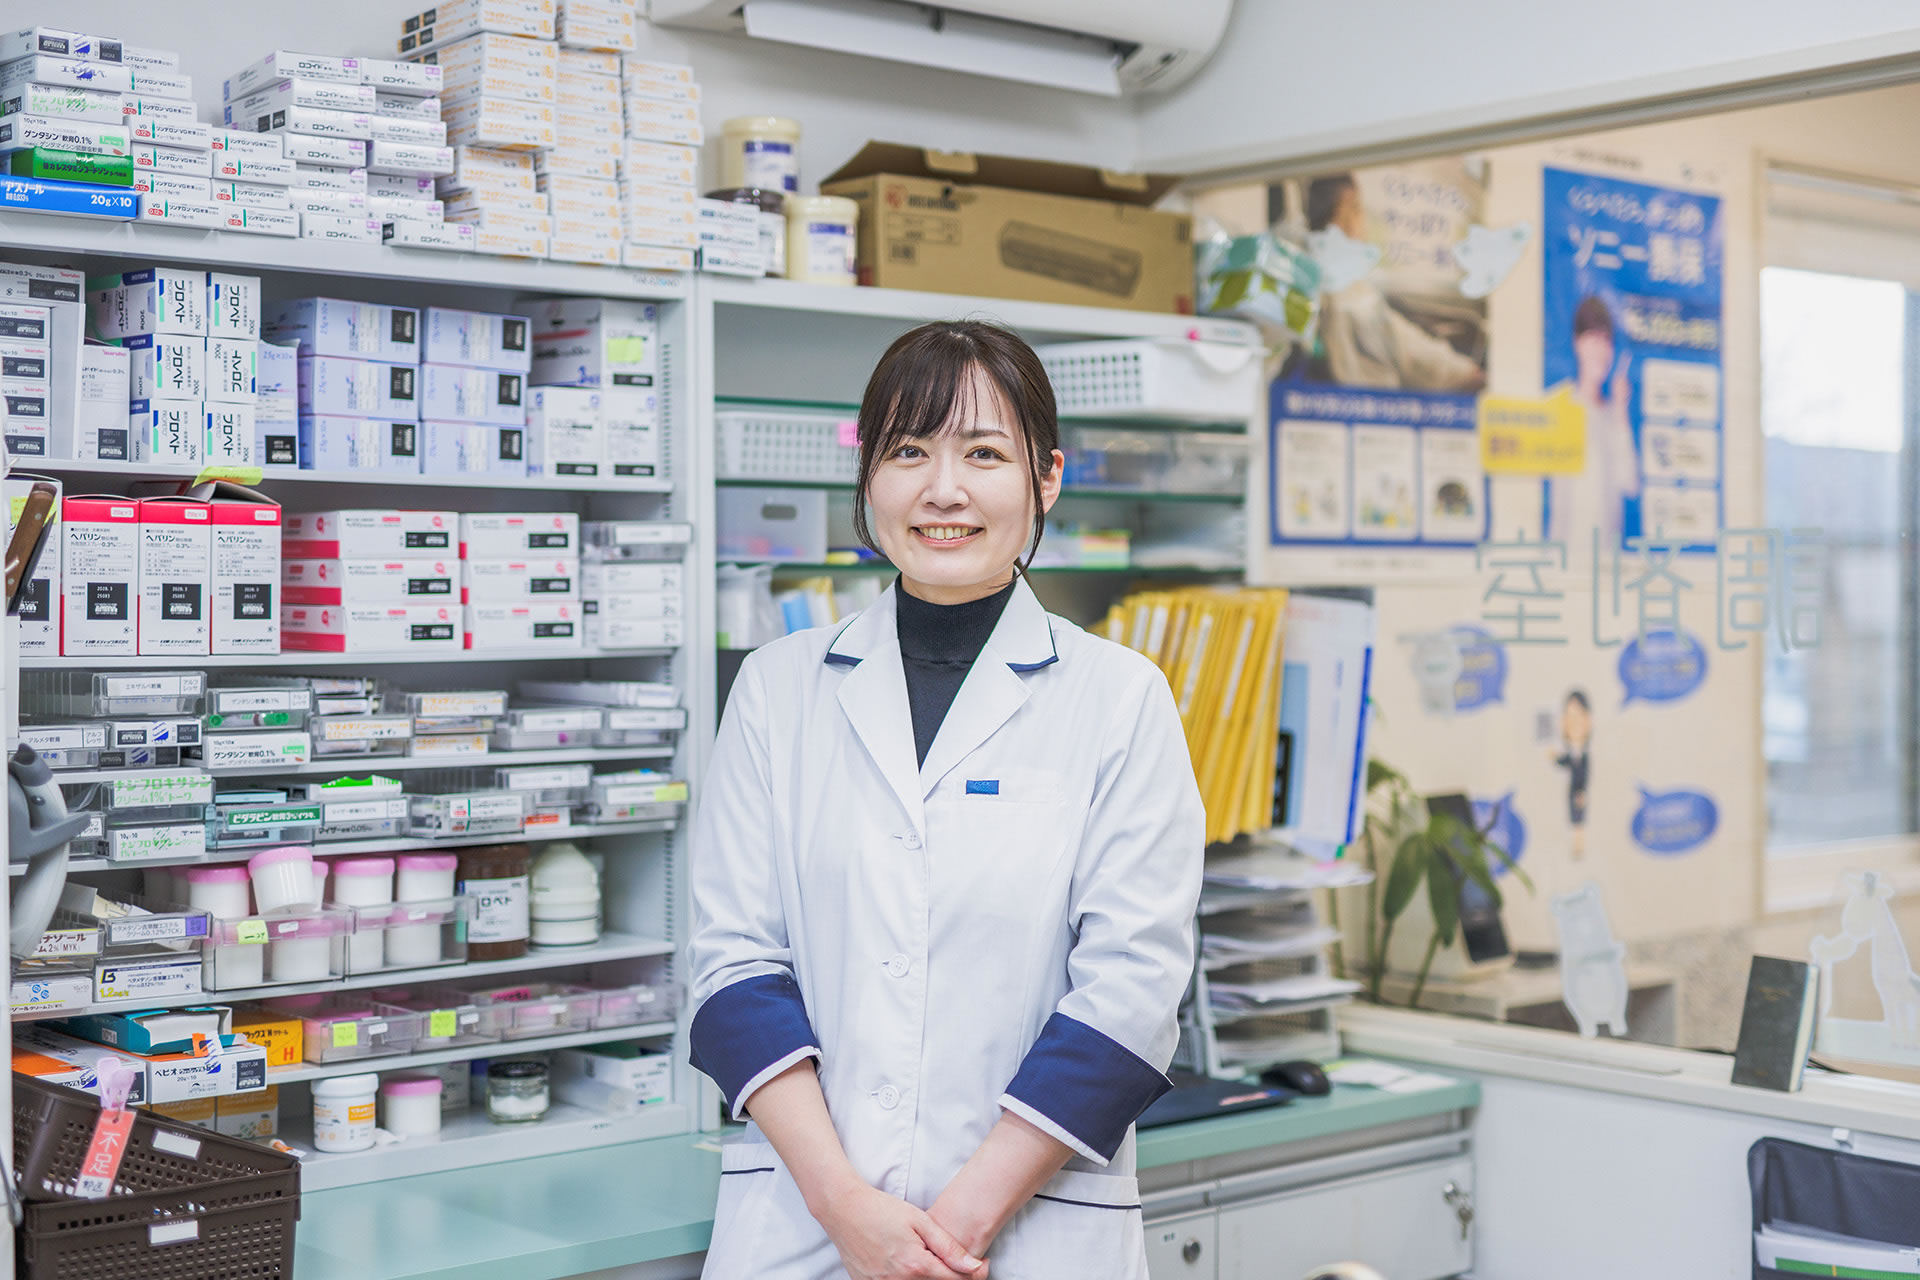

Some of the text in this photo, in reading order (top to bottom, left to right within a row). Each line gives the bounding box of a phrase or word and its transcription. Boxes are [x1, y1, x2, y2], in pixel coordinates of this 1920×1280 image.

[6, 181, 45, 195] アズノール
[174, 280, 185, 324] プロペト
[230, 285, 240, 328] プロペト
[172, 346, 183, 389] プロペト
[169, 410, 180, 454] プロペト
[223, 414, 233, 456] プロペト
[284, 1046, 294, 1061] H
[88, 1131, 121, 1174] 不足
